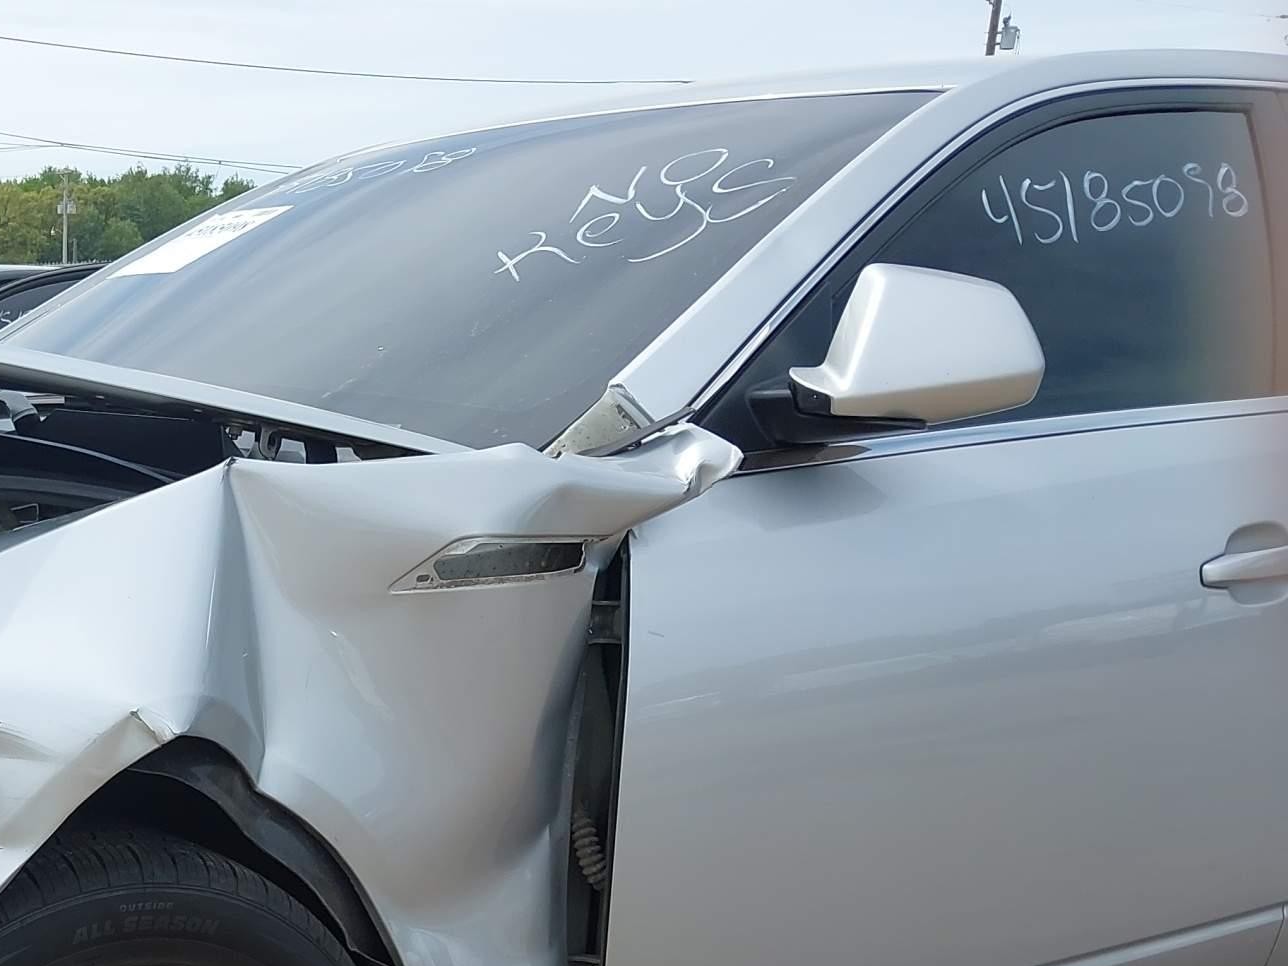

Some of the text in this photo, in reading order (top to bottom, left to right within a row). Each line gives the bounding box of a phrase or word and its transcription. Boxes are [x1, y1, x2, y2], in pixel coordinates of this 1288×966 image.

[981, 162, 1249, 246] 45185098
[119, 901, 176, 913] OUTSIDE
[72, 913, 222, 945] ALL SEASON
